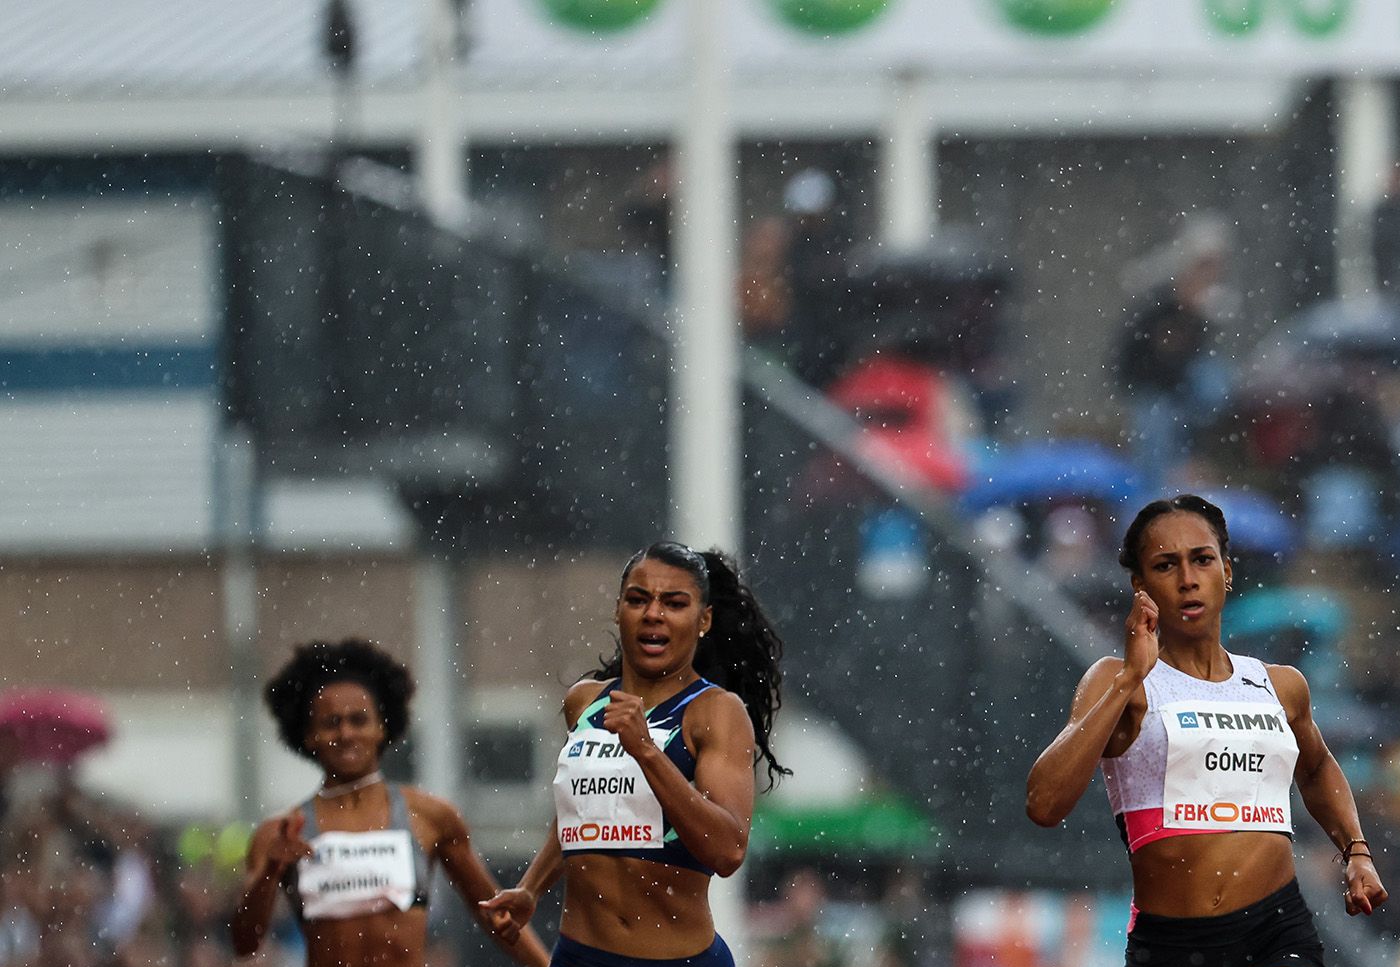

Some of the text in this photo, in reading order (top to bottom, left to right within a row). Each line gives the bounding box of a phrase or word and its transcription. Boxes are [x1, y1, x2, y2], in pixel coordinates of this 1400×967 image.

[1197, 712, 1284, 733] TRIMM
[1205, 747, 1265, 773] GÓMEZ
[571, 777, 635, 796] YEARGIN
[1174, 803, 1285, 824] FBK GAMES
[561, 825, 652, 843] FBK GAMES
